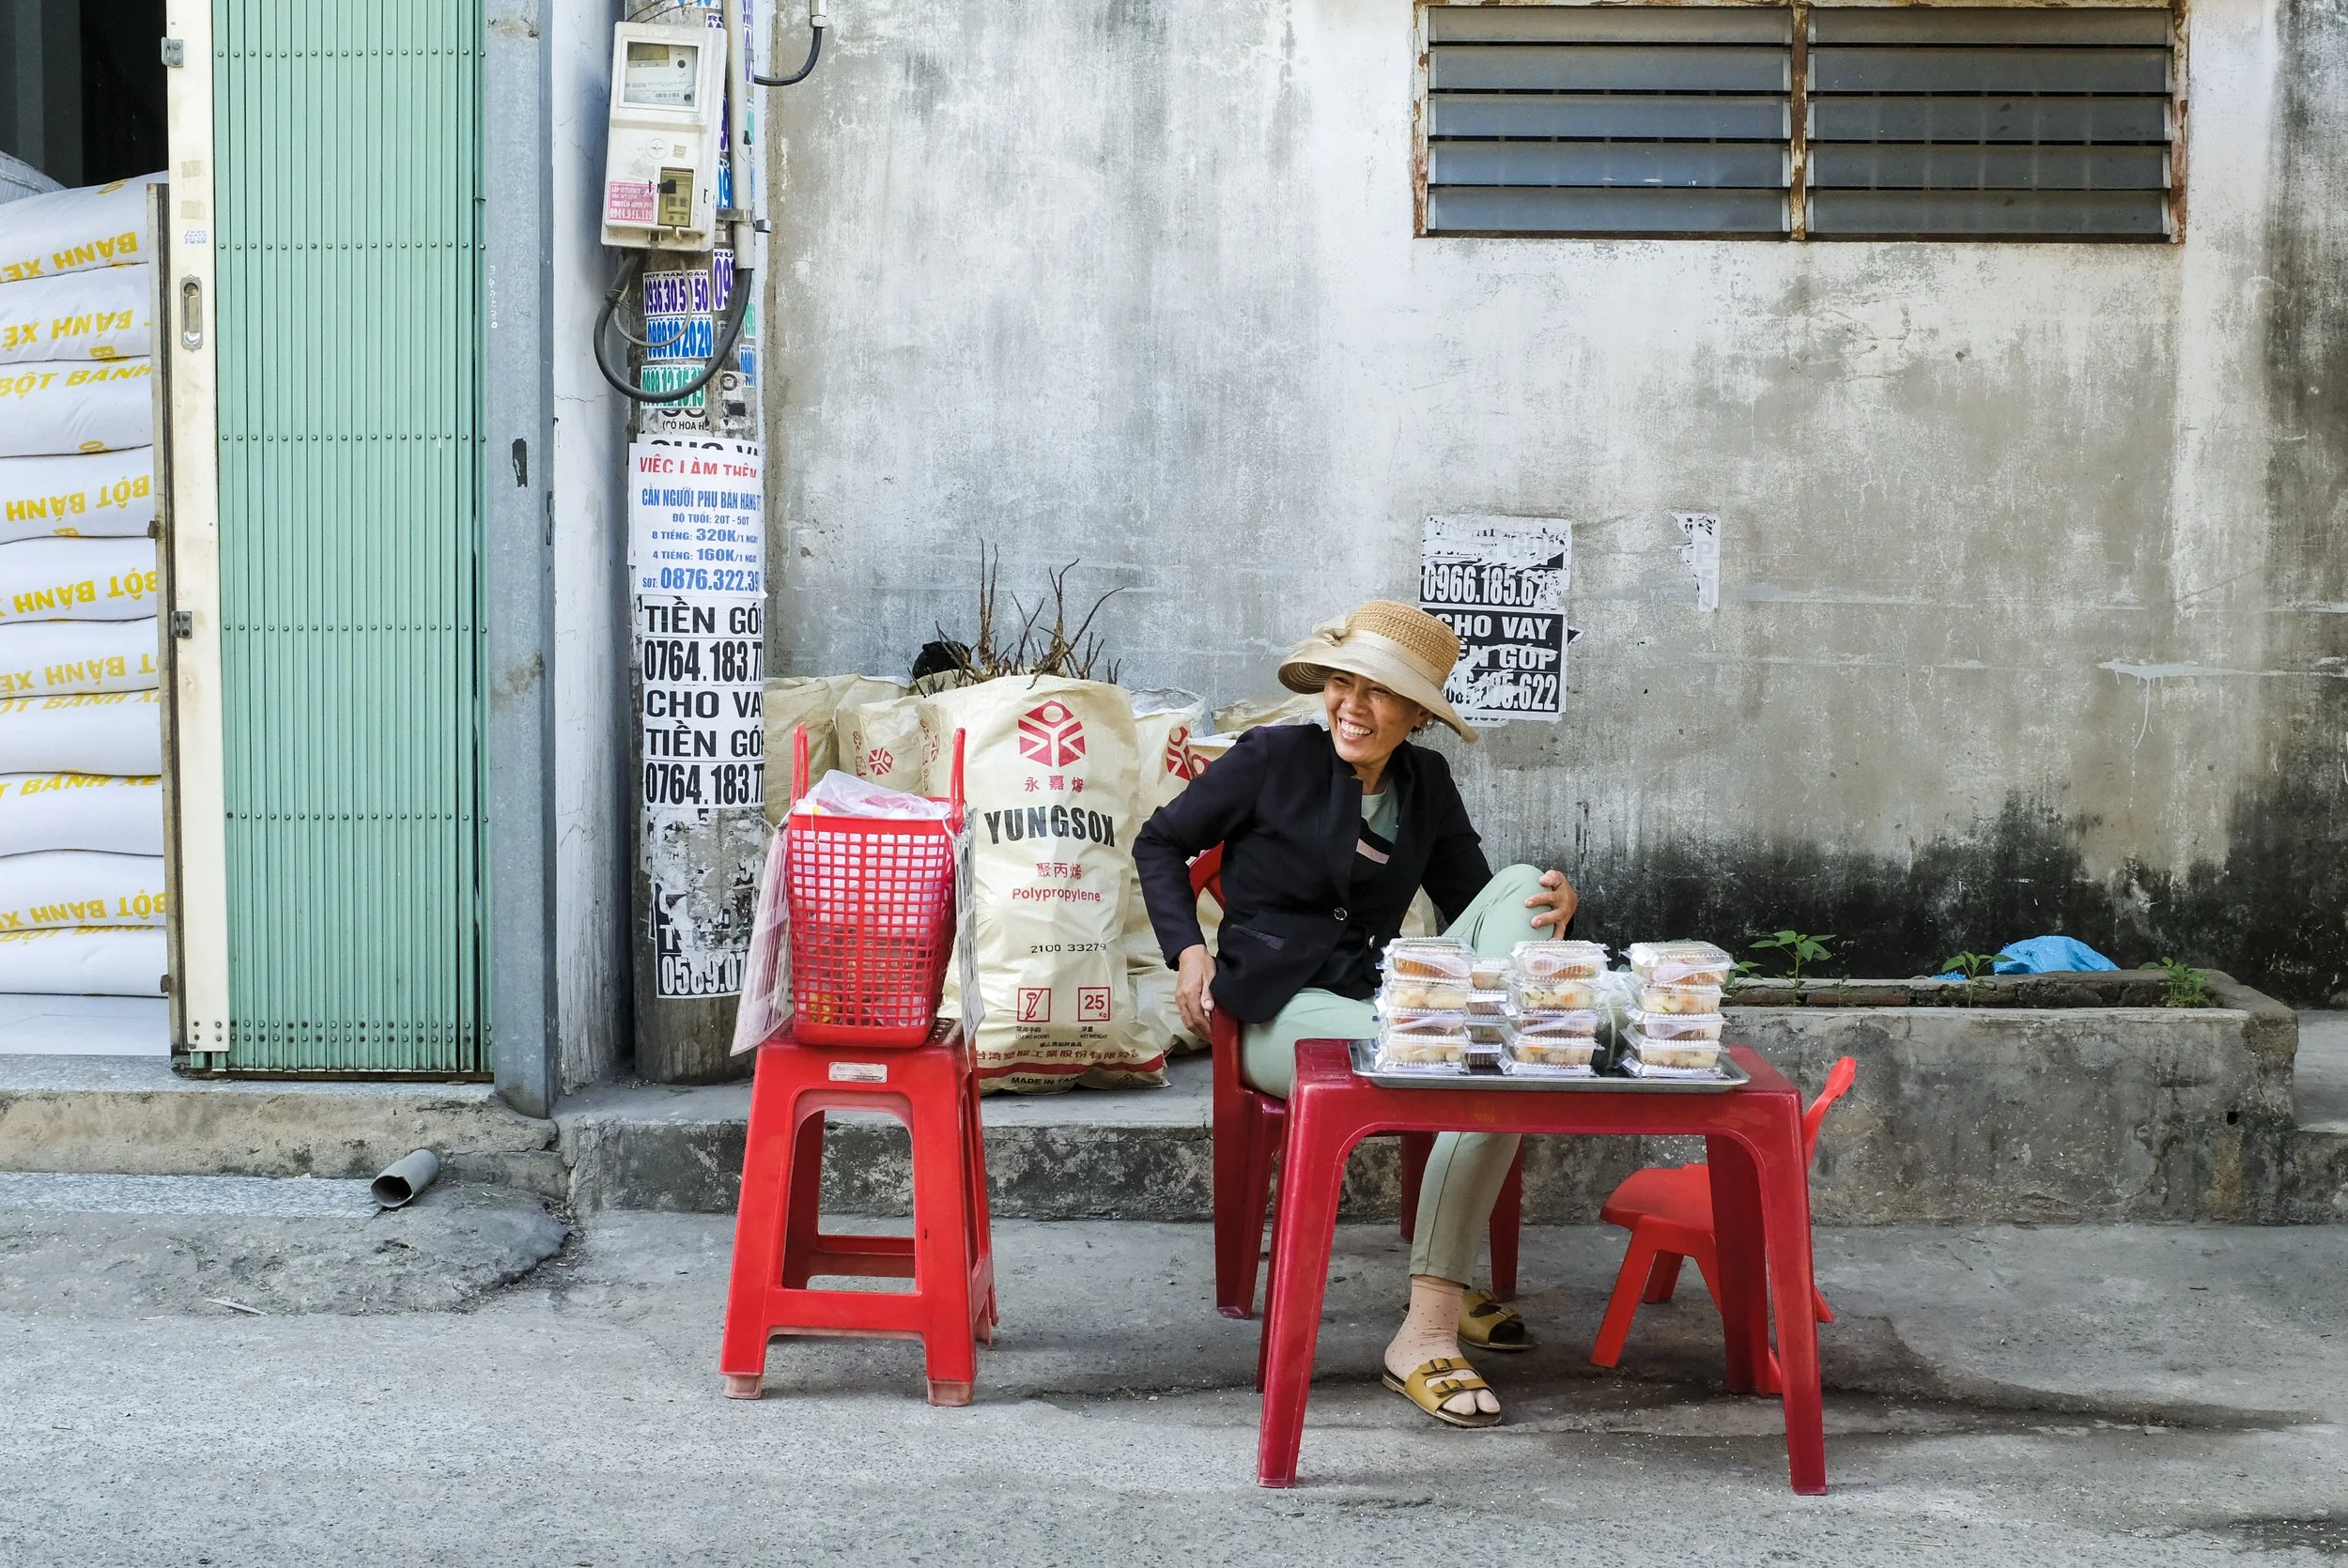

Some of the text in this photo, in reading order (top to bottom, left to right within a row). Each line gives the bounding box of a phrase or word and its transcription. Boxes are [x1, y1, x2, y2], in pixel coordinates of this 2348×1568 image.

[679, 422, 696, 430] HOA
[6, 475, 150, 522] BỘT BÁNH
[652, 530, 658, 540] 8
[653, 550, 658, 559] 4
[13, 580, 97, 613] BÁNH
[644, 595, 716, 634] TIỀN
[1501, 616, 1552, 640] VAY
[647, 690, 718, 718] CHO
[646, 720, 717, 757] TIỀN
[1025, 775, 1084, 793] 永嘉烯
[1036, 863, 1082, 880] 聚丙烯
[1012, 886, 1101, 902] Polypropylene
[1031, 944, 1061, 953] 2100
[1084, 995, 1104, 1010] 25
